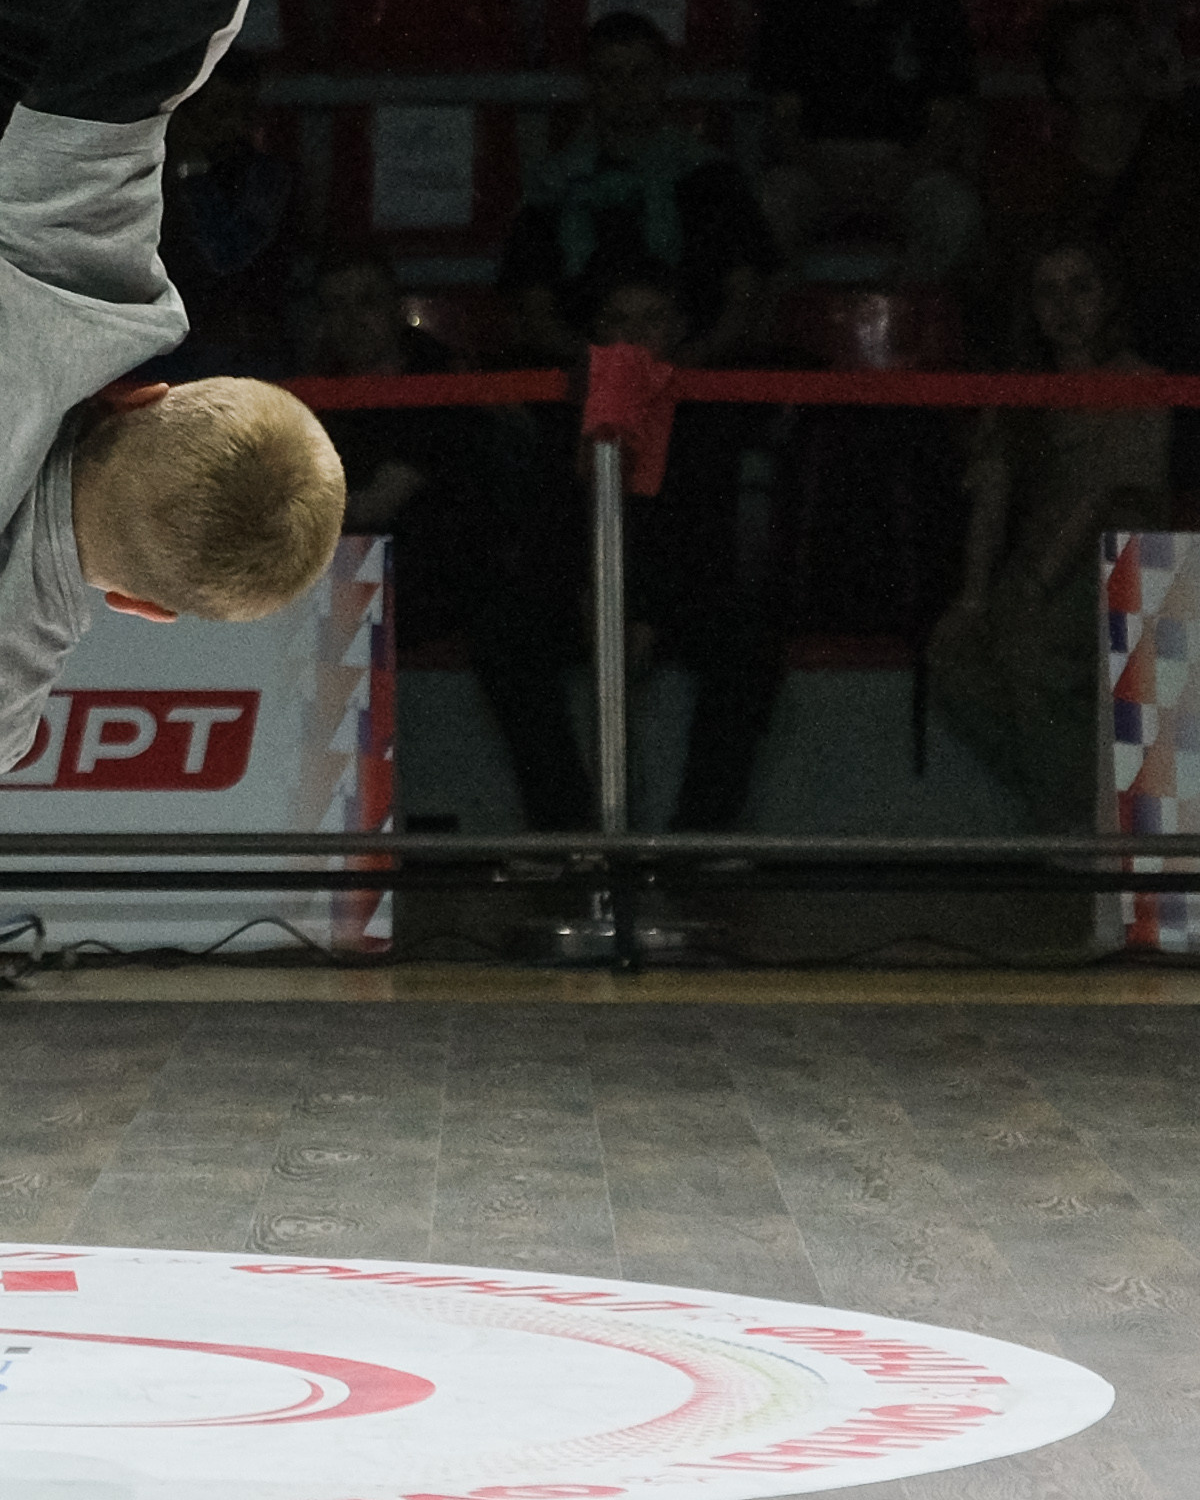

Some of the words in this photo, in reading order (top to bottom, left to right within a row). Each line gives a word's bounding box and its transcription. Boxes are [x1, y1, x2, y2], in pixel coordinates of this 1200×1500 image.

[230, 1261, 714, 1312] ФИНАЛ
[742, 1326, 1010, 1387] ФИНАЛ
[674, 1403, 1006, 1474] ФИНАЛ
